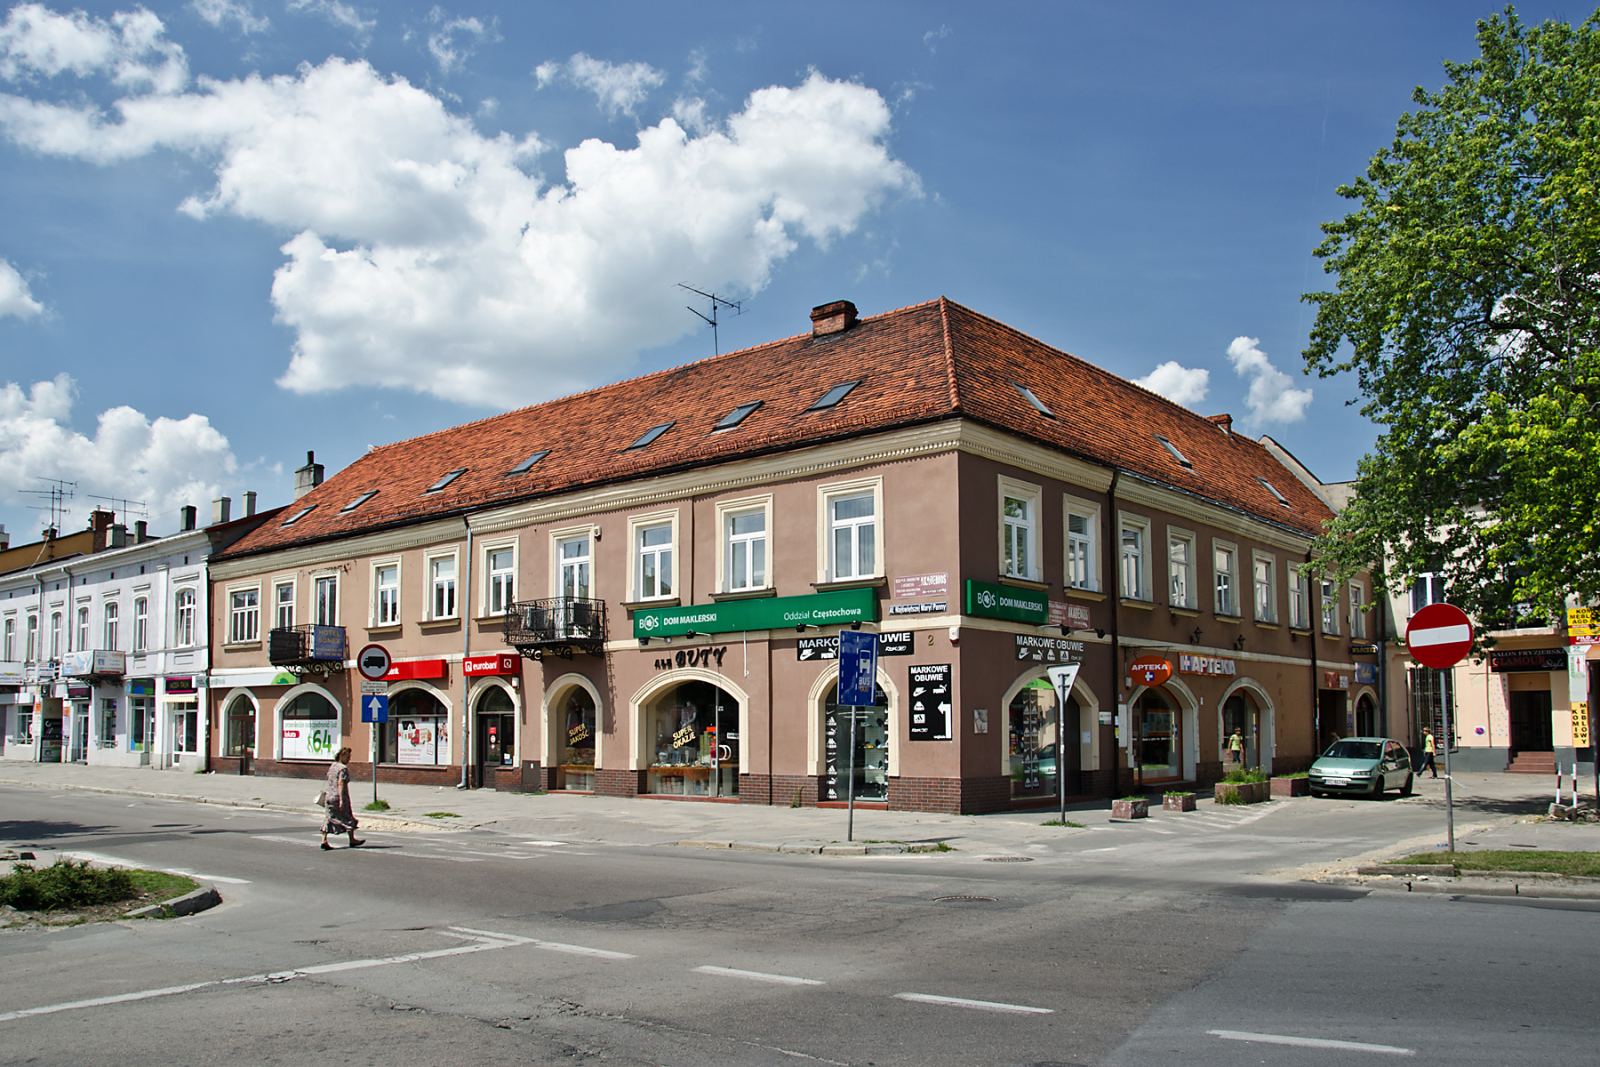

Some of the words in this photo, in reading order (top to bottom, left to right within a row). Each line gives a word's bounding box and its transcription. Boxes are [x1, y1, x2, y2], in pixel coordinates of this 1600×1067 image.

[1000, 597, 1014, 607] DOM
[1014, 599, 1043, 612] MAKLERSKI
[663, 616, 679, 626] DOM
[680, 613, 717, 624] MAKLERSKI
[812, 608, 862, 619] Częstochowa
[799, 638, 839, 649] MARKO
[880, 632, 911, 643] UWIE
[927, 634, 935, 646] 2
[1016, 635, 1055, 649] MARKOWE
[1056, 640, 1084, 652] OBUWIE
[675, 646, 727, 668] BUTY
[473, 661, 497, 670] euroban
[910, 665, 948, 674] MARKOWE
[1131, 663, 1168, 671] APTEKA
[1191, 656, 1236, 675] APTEKA
[859, 677, 870, 686] BUS
[914, 674, 944, 682] OBUWIE
[1571, 710, 1579, 738] KOMIS
[1580, 703, 1588, 744] MEBLOWY
[672, 725, 693, 740] SUPER
[673, 731, 696, 749] OKAZJE
